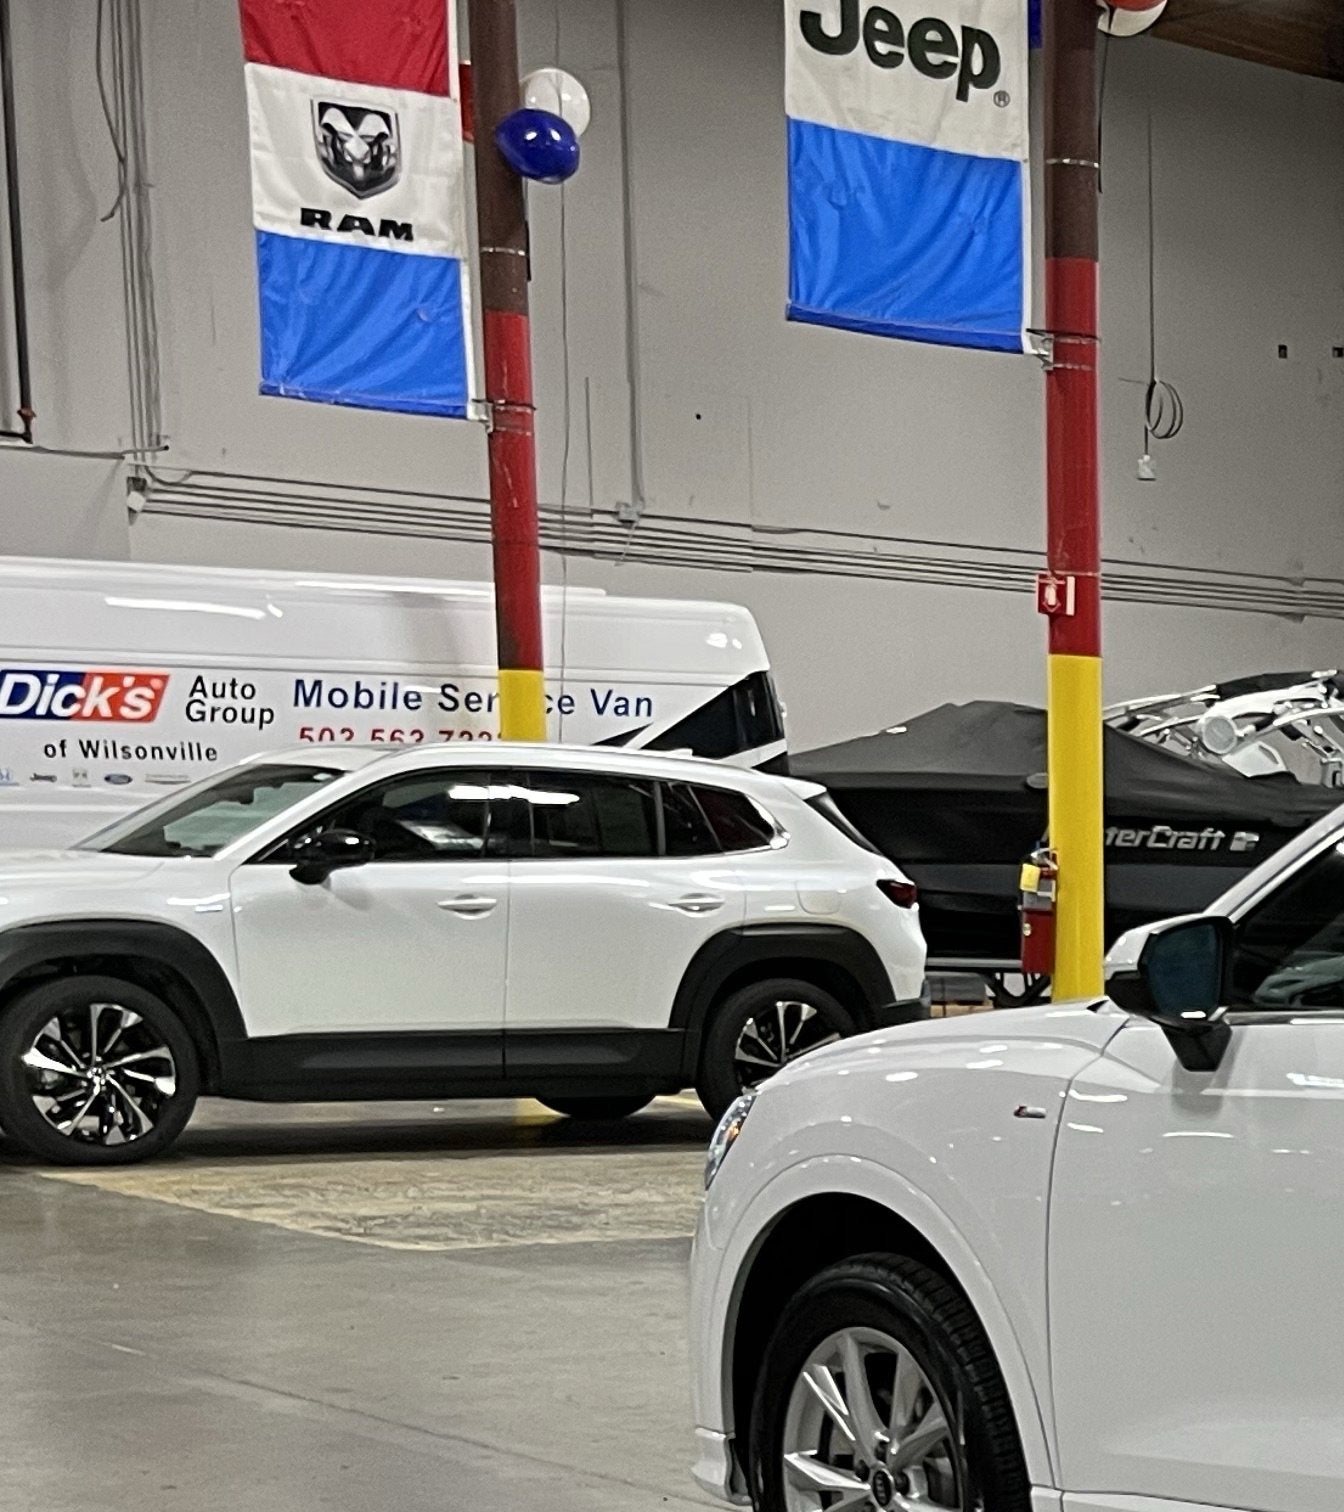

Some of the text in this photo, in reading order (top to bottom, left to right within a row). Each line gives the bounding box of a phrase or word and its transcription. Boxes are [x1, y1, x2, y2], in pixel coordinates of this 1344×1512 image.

[300, 207, 414, 242] RAM
[189, 675, 257, 701] Auto
[293, 678, 423, 711] Mobile
[590, 687, 654, 718] Van
[185, 698, 275, 731] Group
[44, 738, 218, 762] of Wilsonville
